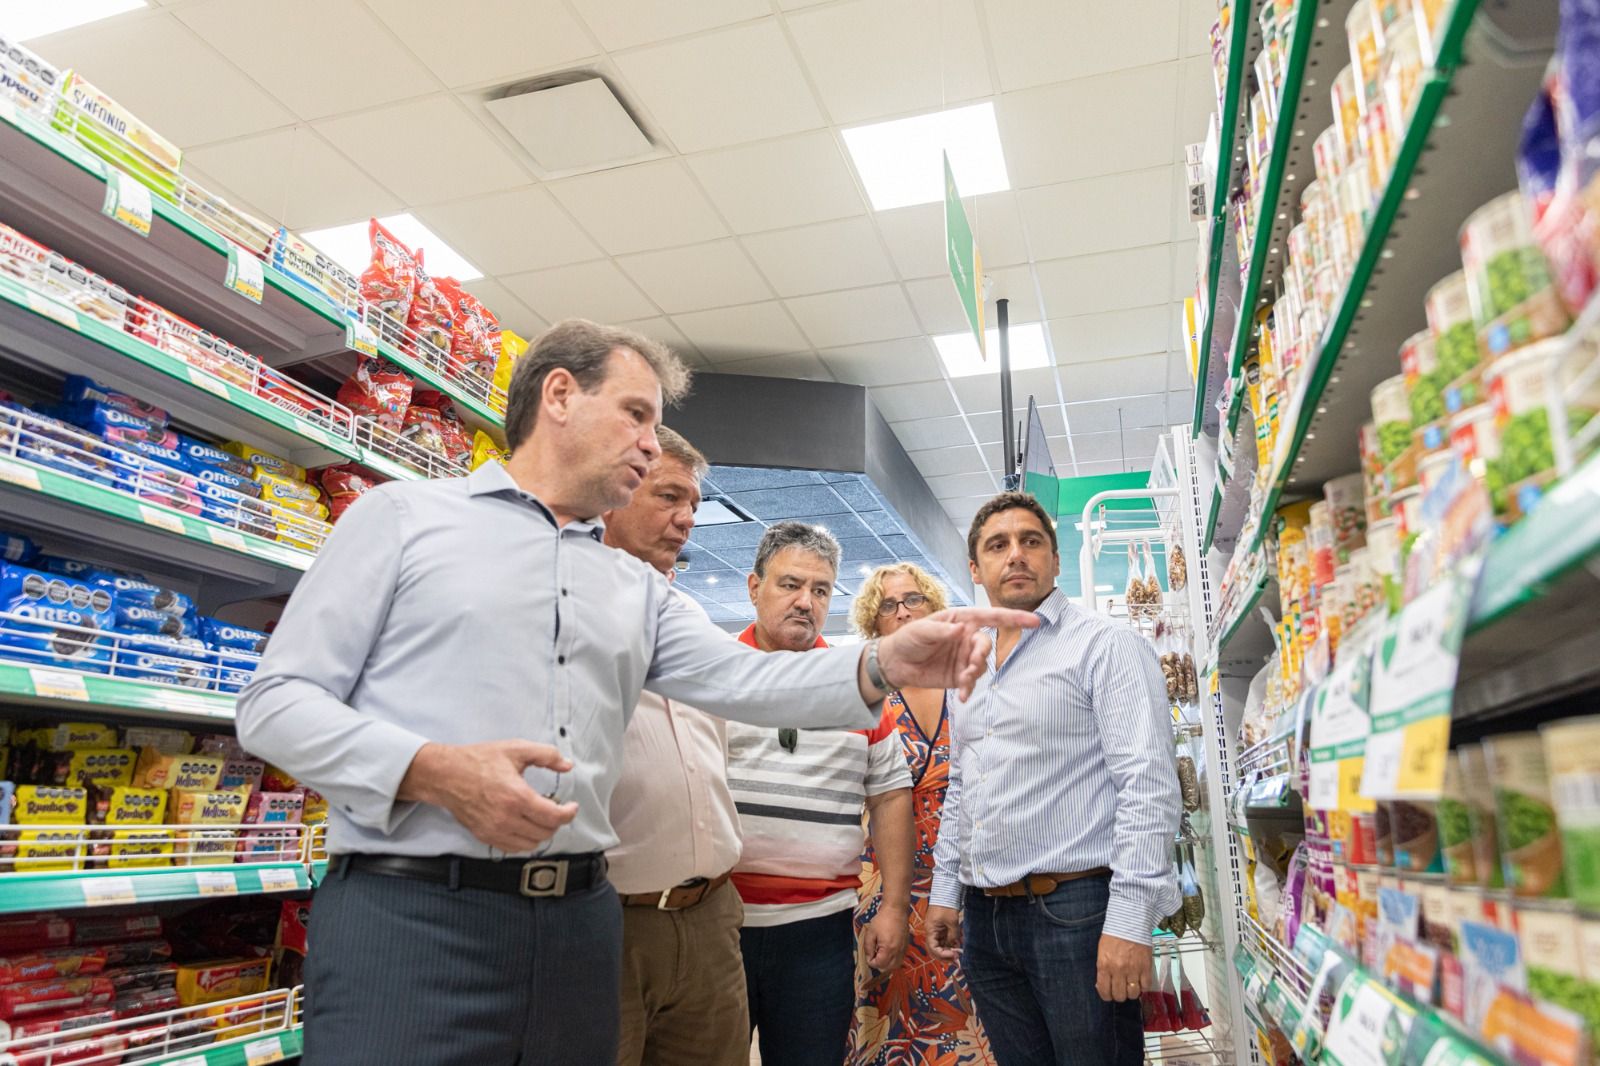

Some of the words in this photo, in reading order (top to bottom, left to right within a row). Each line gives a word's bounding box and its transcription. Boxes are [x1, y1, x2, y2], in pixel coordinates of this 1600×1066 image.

[190, 445, 230, 462] OREO
[200, 469, 240, 487] OREO
[12, 604, 82, 624] OREO
